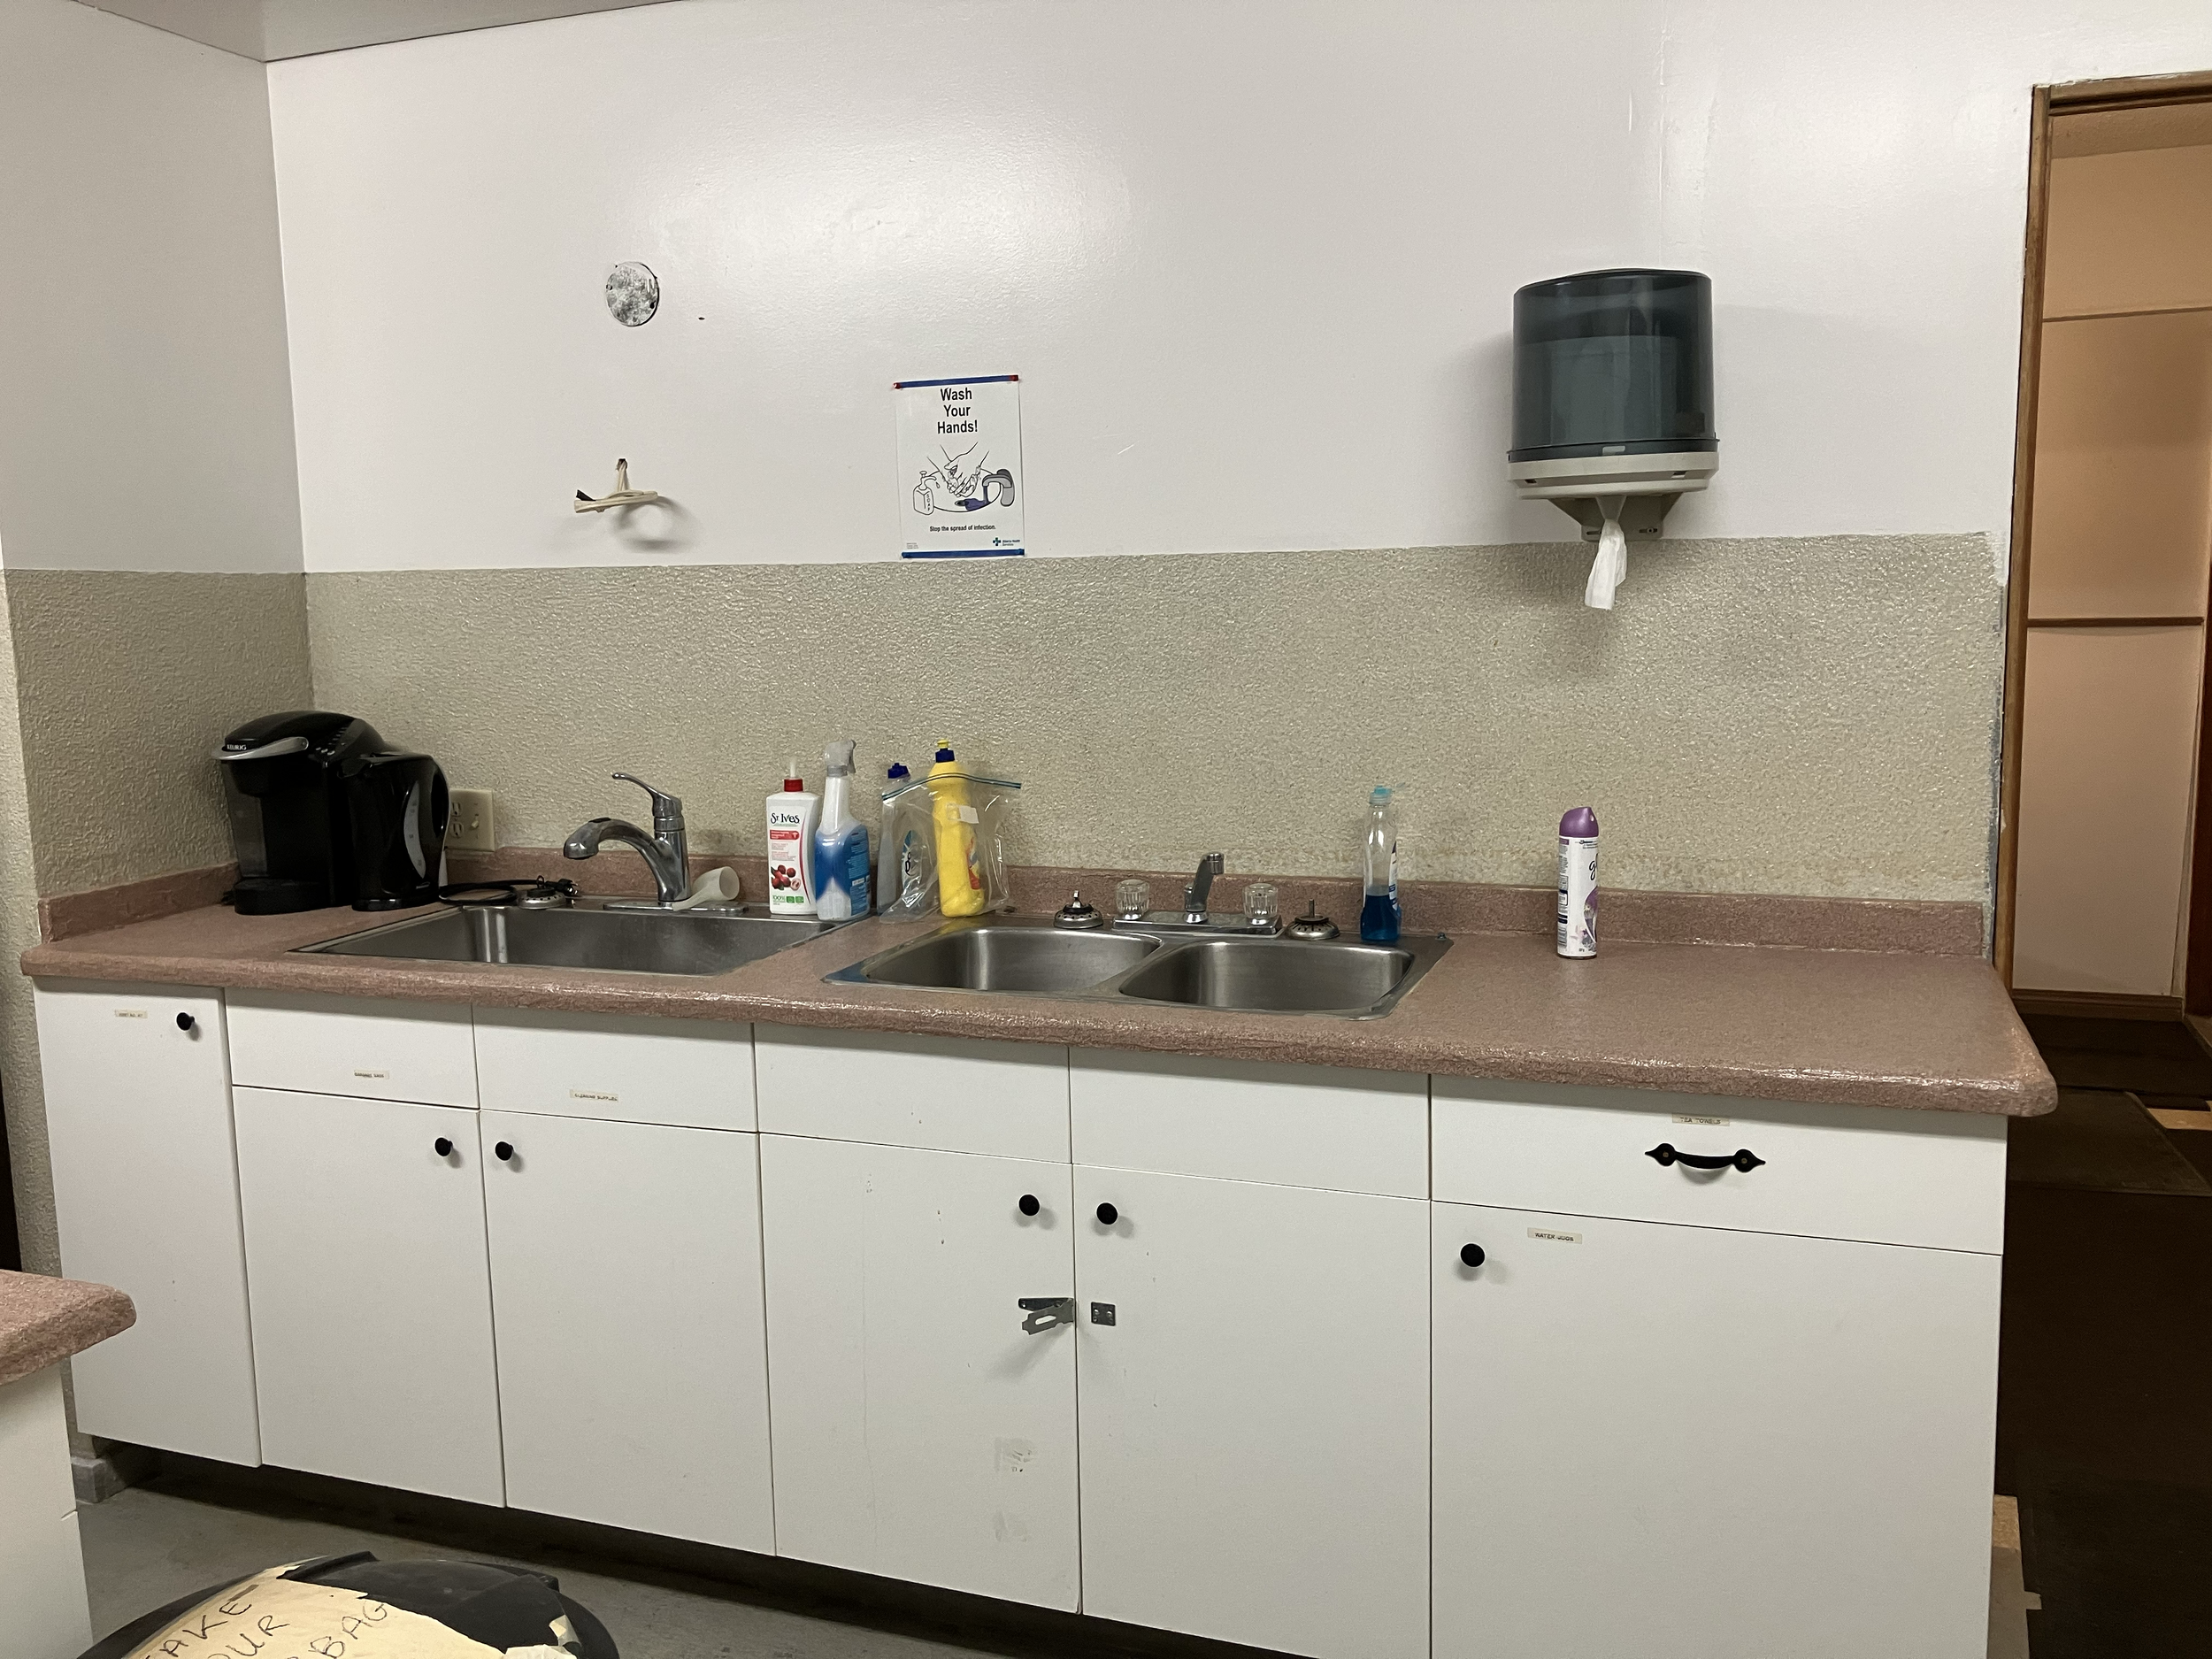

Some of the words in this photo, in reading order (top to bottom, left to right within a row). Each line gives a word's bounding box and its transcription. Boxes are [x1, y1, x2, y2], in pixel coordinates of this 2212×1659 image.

[940, 387, 972, 402] Wash
[943, 404, 972, 418] Your
[937, 419, 979, 434] Hands!
[145, 1601, 253, 1659] AKE
